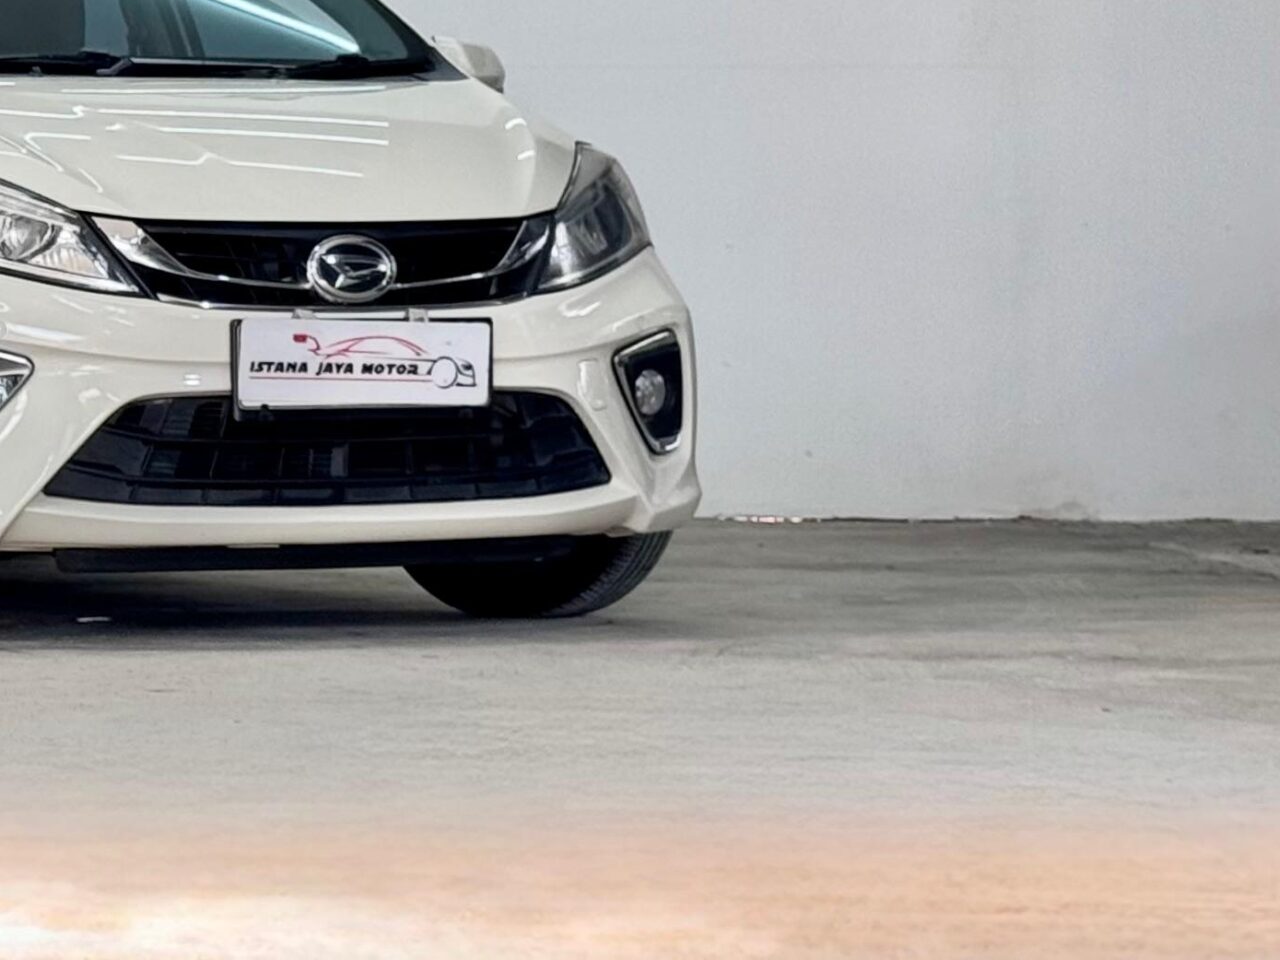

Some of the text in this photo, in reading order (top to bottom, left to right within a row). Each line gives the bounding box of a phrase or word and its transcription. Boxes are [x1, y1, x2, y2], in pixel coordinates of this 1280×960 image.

[249, 361, 419, 376] ISTANA JAYA MOTOR
